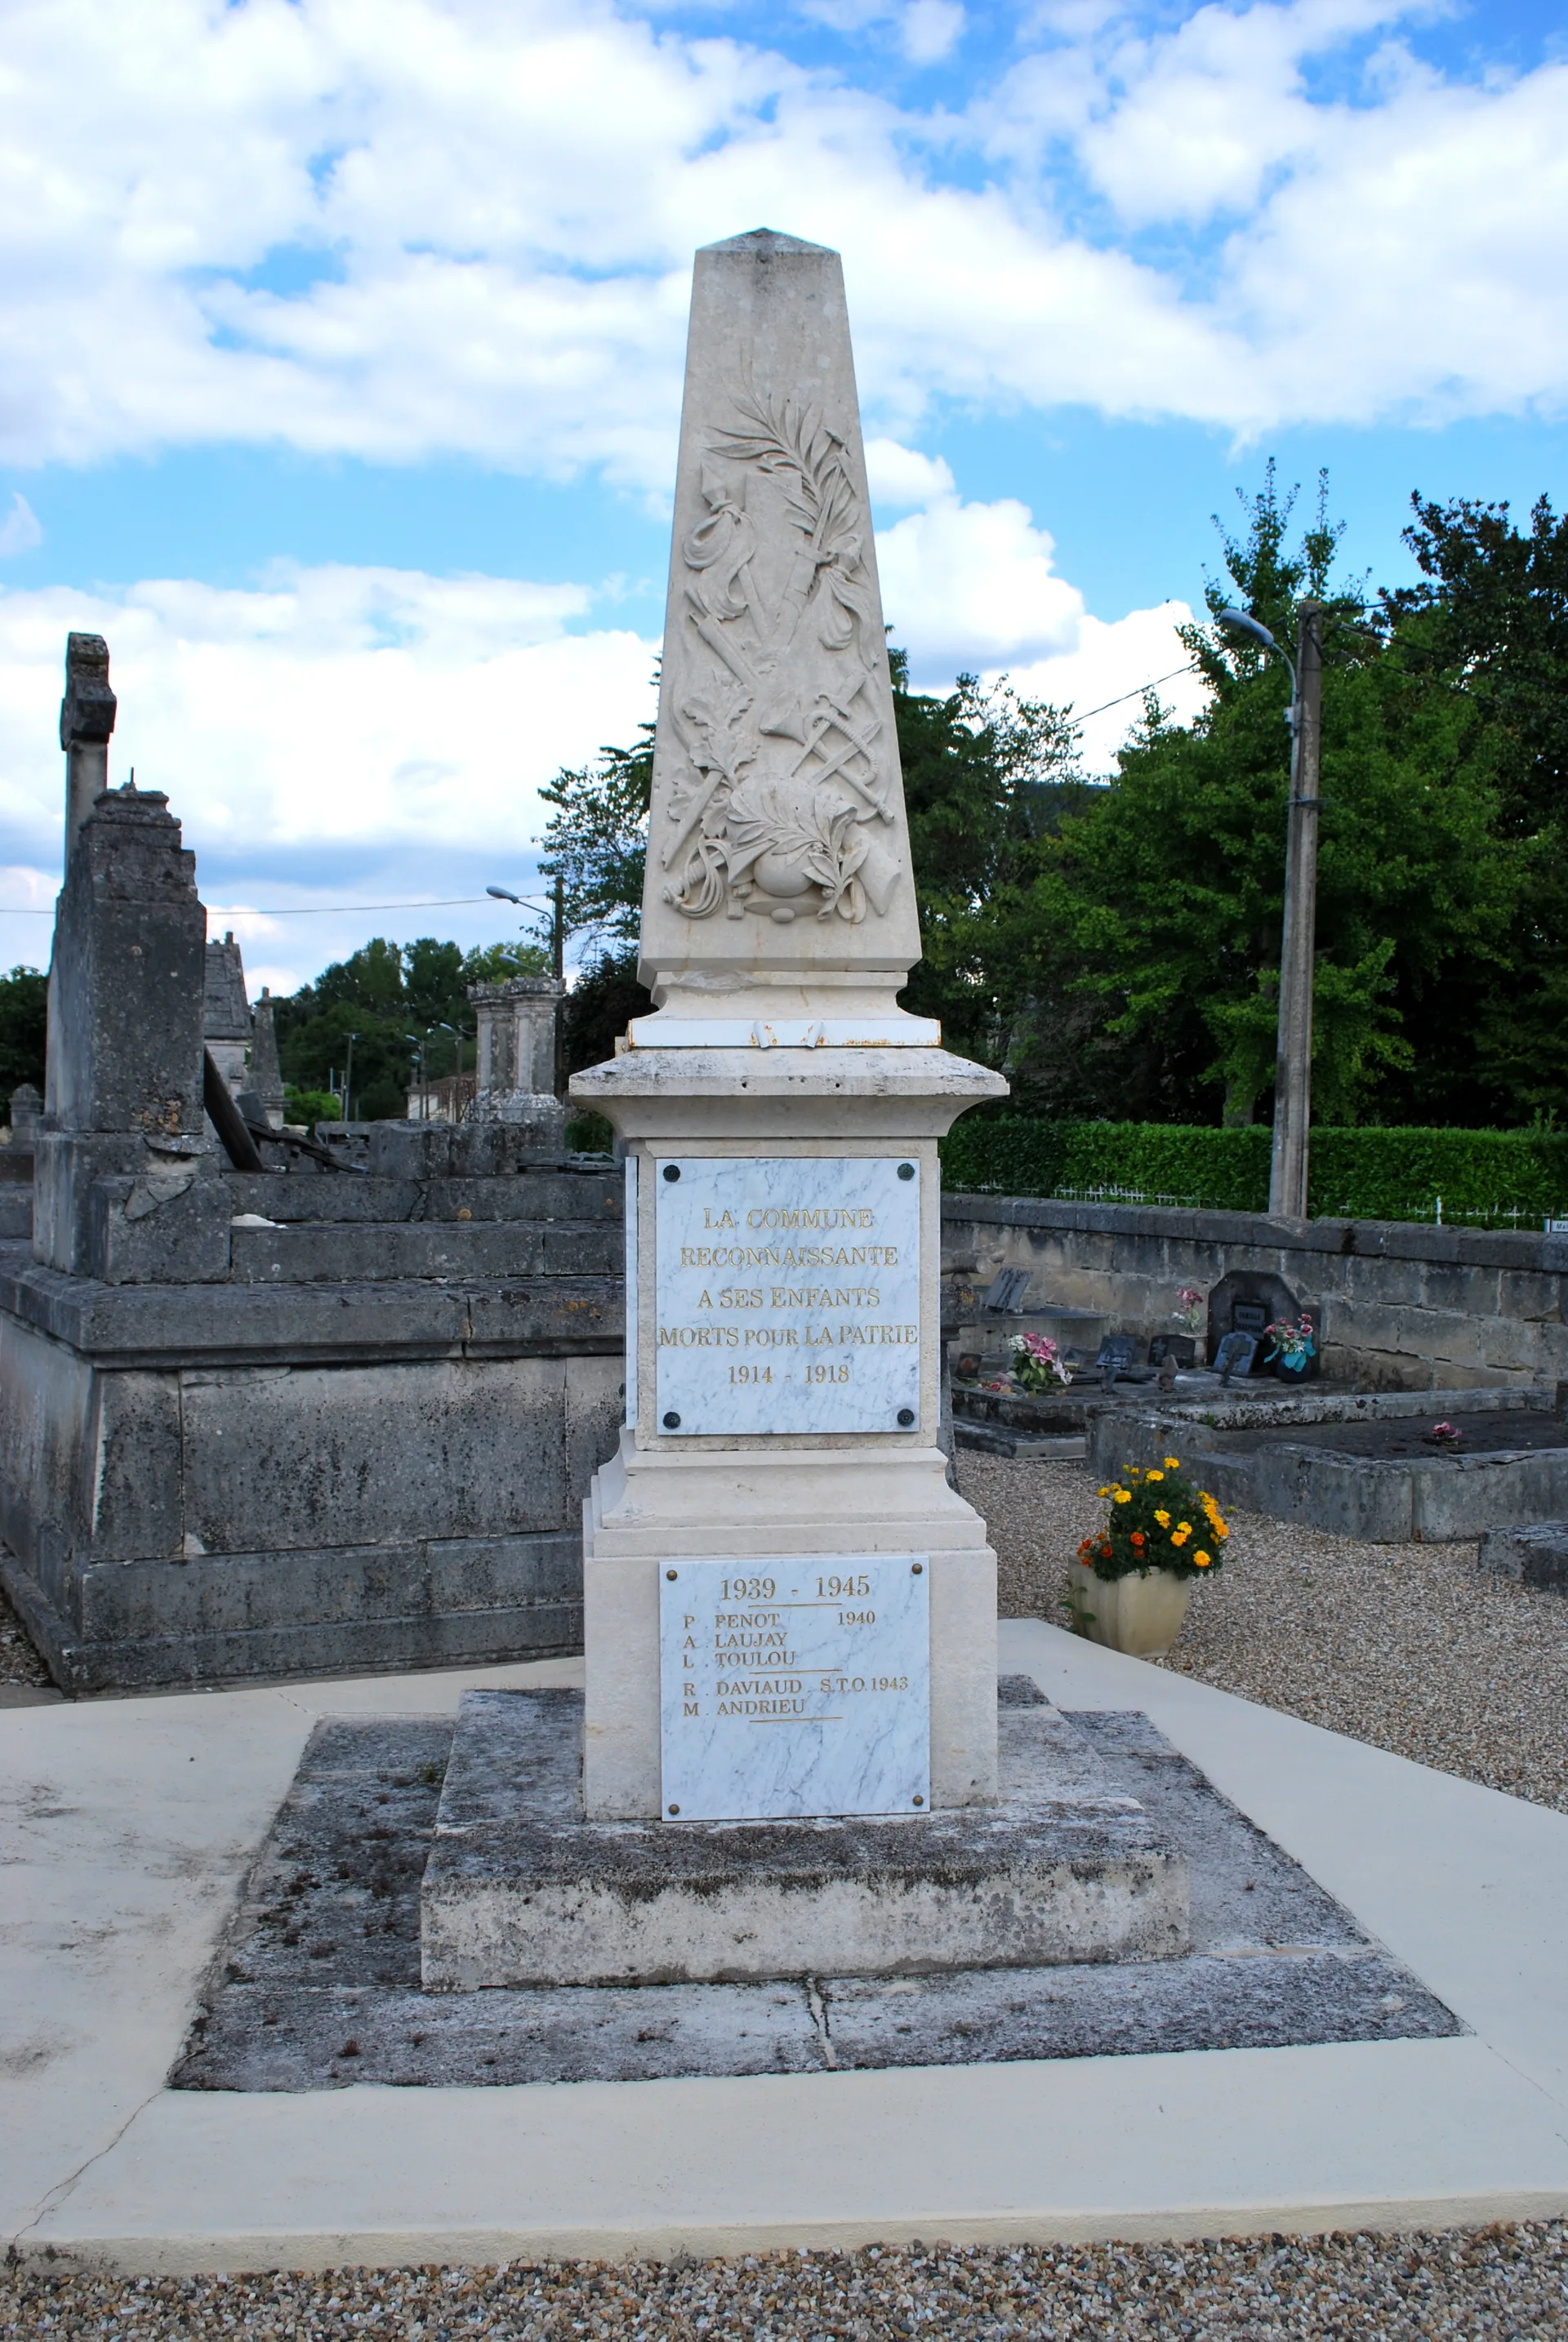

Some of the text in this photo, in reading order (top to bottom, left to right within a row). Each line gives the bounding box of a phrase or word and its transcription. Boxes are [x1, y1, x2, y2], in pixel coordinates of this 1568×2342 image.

[703, 1208, 874, 1229] LA COMMUNE
[680, 1246, 898, 1267] RECONNAISSANTE
[697, 1287, 880, 1309] A SES ENFANTS
[659, 1325, 919, 1347] MORTS POUR LA PATRIE
[728, 1365, 773, 1385] 1914
[804, 1365, 850, 1384] 1918
[720, 1578, 776, 1601] 1939
[815, 1575, 871, 1598] 1945
[715, 1613, 780, 1629] PENOT
[838, 1610, 875, 1626] 1940
[715, 1632, 788, 1649] LAUJAY
[715, 1651, 795, 1667] TOULOU
[716, 1680, 802, 1696] DAVIAUD
[717, 1699, 805, 1715] ANDRIEU
